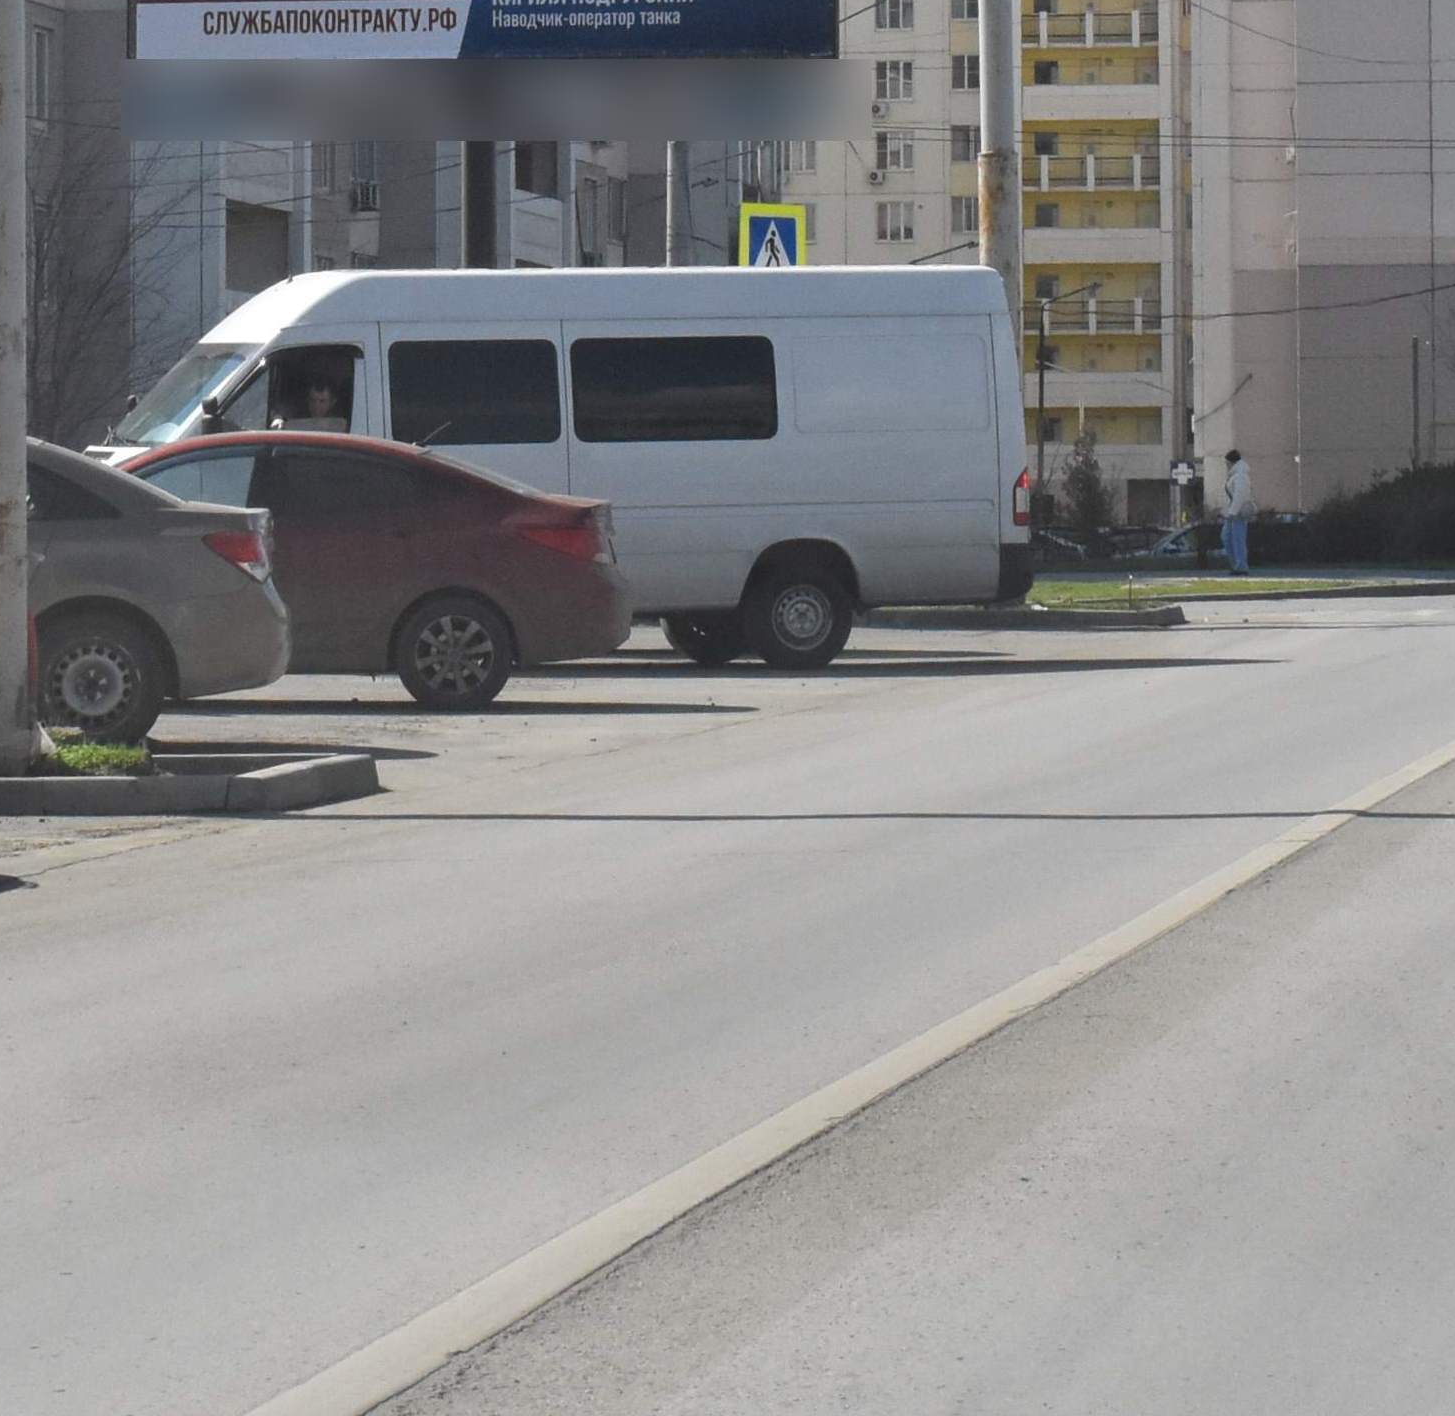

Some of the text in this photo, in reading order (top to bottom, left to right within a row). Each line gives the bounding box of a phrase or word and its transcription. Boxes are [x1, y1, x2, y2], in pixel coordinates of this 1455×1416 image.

[203, 8, 457, 35] СЛУЖБАПОКОНТРАКТУ.РФ
[492, 10, 681, 29] Наводчик-оператор танка
